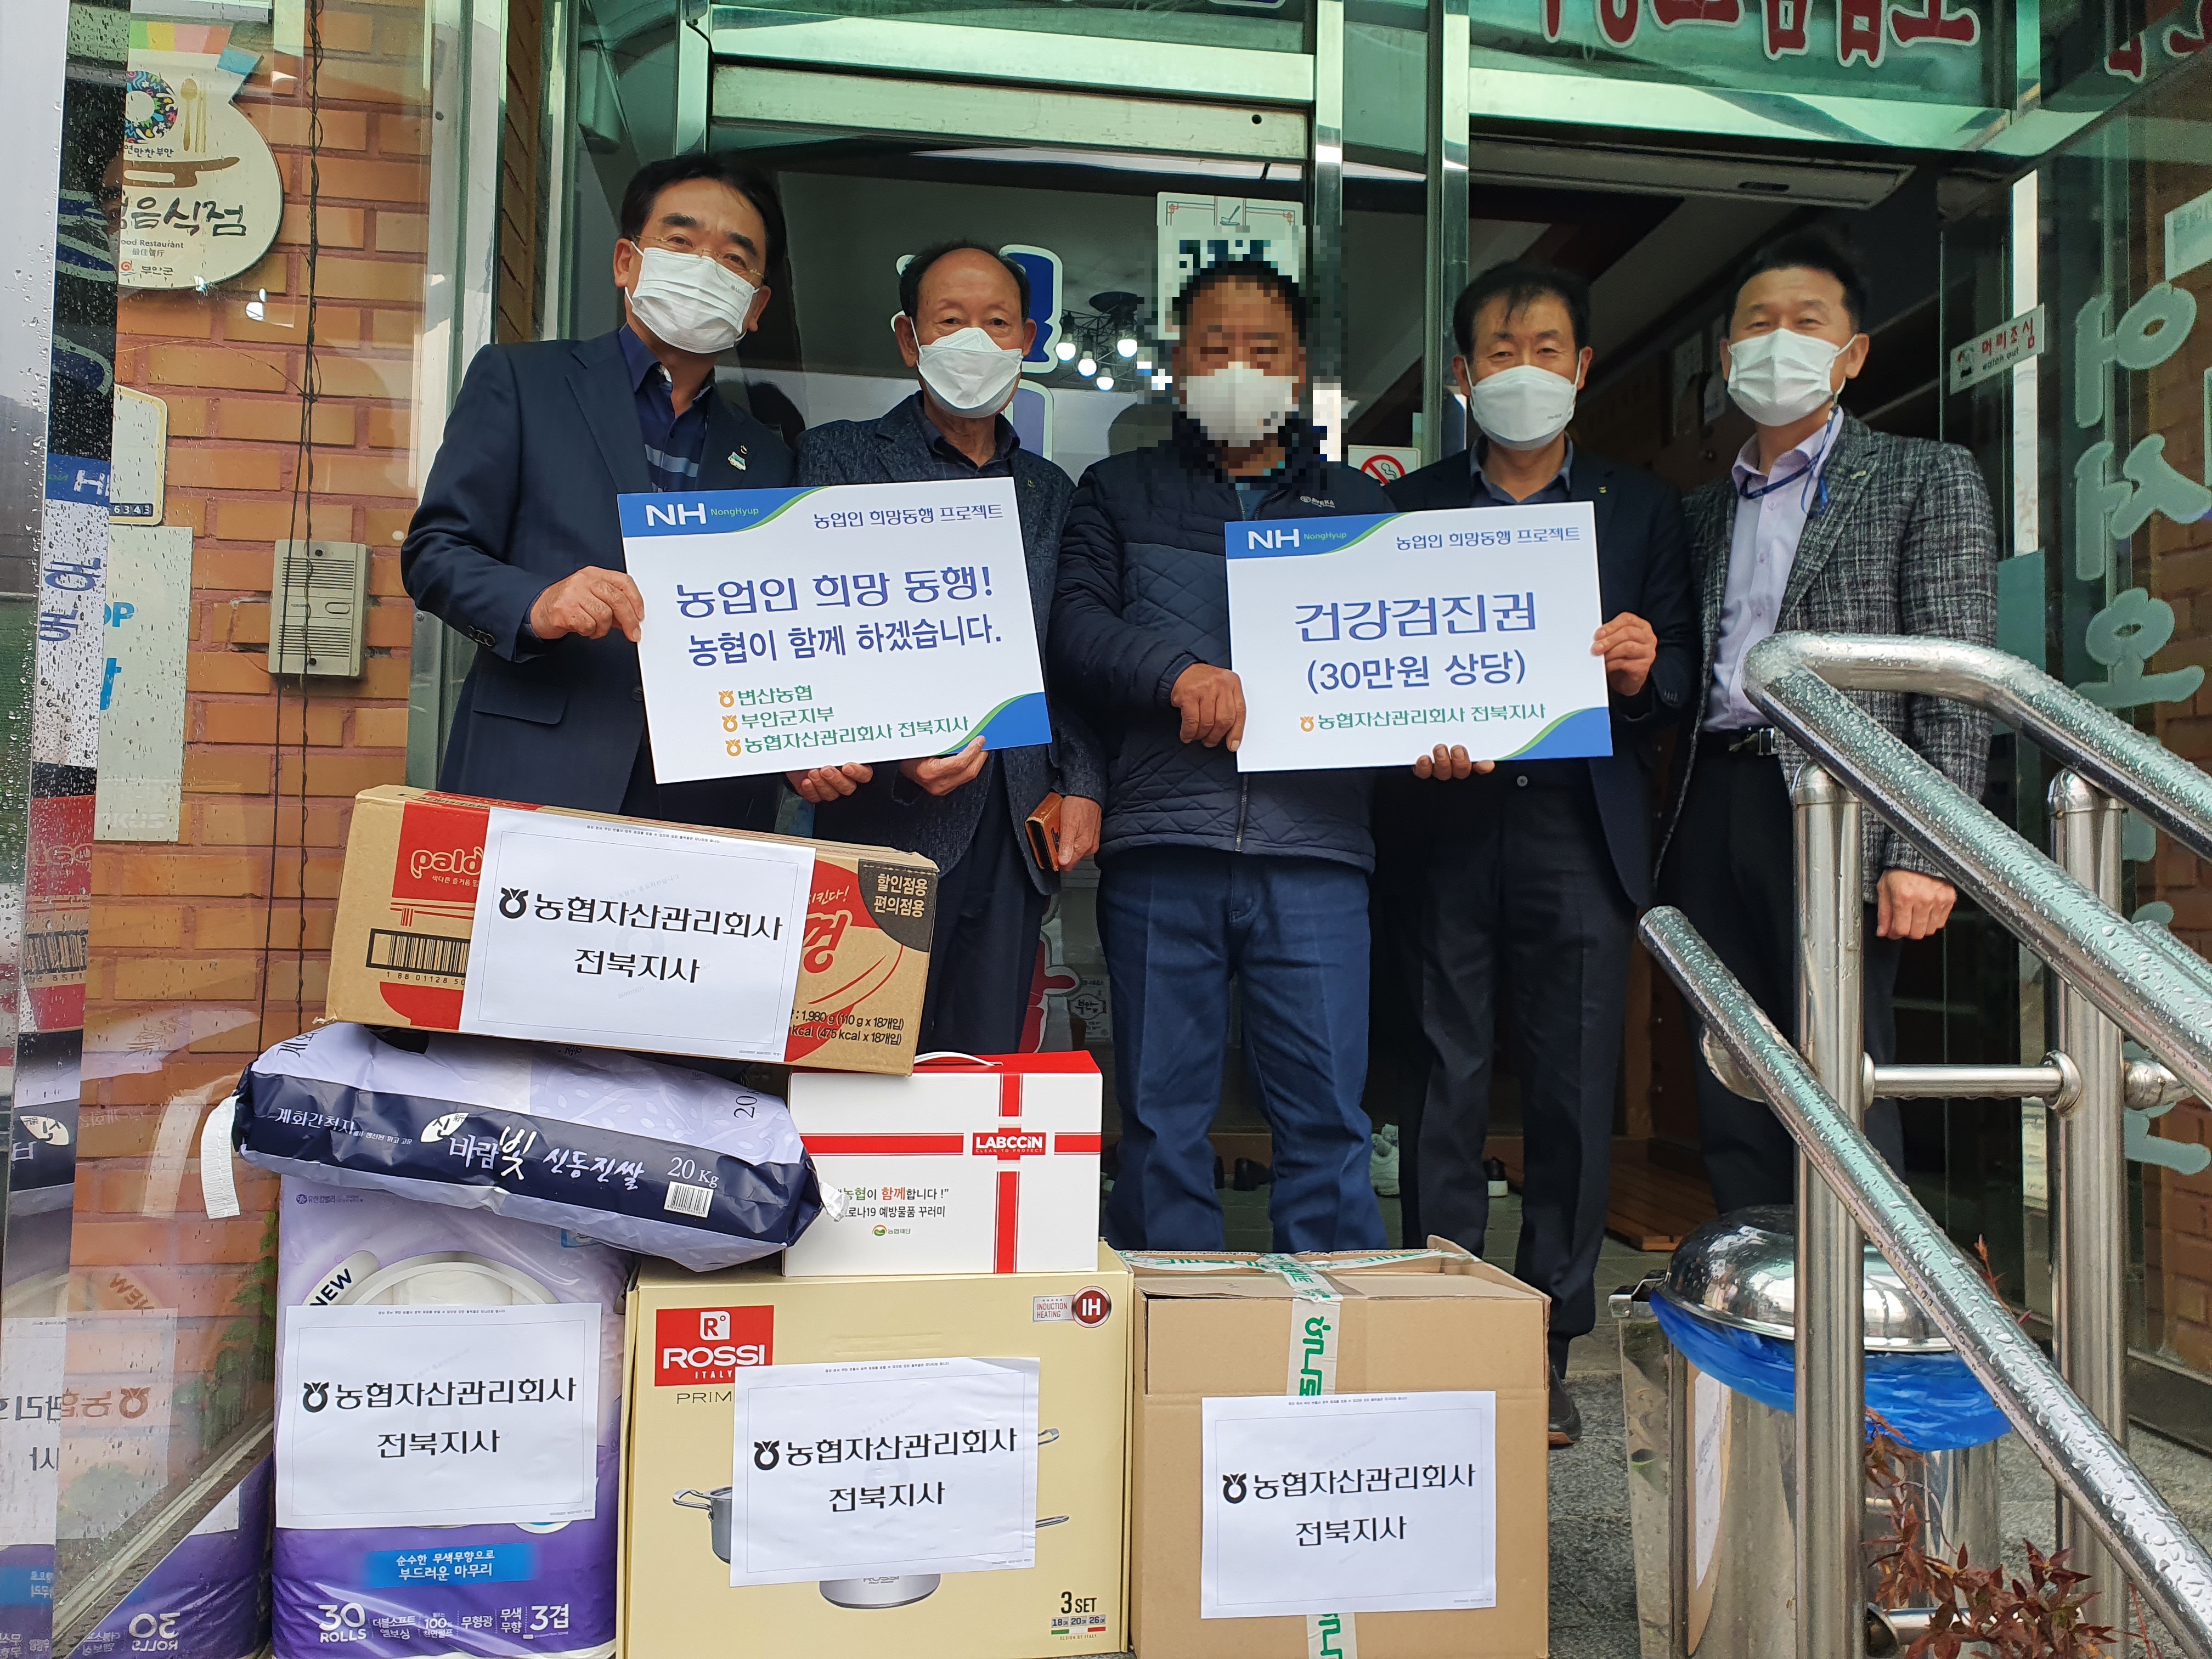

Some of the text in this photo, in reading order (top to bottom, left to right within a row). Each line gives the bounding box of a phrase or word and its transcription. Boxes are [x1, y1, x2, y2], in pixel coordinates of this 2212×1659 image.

[140, 239, 184, 248] Restaurant
[141, 266, 173, 275] 부안군
[1982, 317, 2035, 355] 머리조심
[113, 504, 153, 516] 6343
[646, 502, 759, 526] NH NongHyup
[814, 504, 1004, 529] 농업인 희망동행 프로젝트
[1248, 528, 1347, 550] NH NongHyup
[1396, 527, 1581, 550] 농업인 희망동행 프로젝트
[676, 566, 994, 618] 농업인 희망 동행!
[1295, 592, 1536, 642] 건강검진권
[689, 614, 1002, 667] 농협이 함께 하겠습니다.
[1307, 650, 1526, 693] (30만원 상당)
[738, 685, 813, 707] 변산농협
[742, 707, 834, 729] 부안군지부
[1318, 703, 1546, 730] 농협자산관리회사 전북지사
[744, 716, 968, 753] 농협자산관리회사 전북지사
[432, 875, 450, 884] 색다른
[453, 877, 470, 887] 즐거움
[877, 873, 928, 896] 할인점용
[534, 893, 783, 941] 농협자산관리회사
[873, 895, 925, 918] 편의점용
[574, 949, 700, 984] 전북지사
[416, 974, 448, 984] 01128
[802, 1010, 826, 1022] 1,980
[828, 1015, 834, 1024] g
[837, 1013, 855, 1025] (110
[856, 1018, 862, 1027] g
[873, 1018, 904, 1030] 18개입)
[792, 1026, 813, 1037] kcal
[817, 1026, 837, 1039] (475
[839, 1030, 860, 1041] kcal
[871, 1032, 902, 1046] 18개입)
[275, 1108, 354, 1135] 계화간척지
[544, 1148, 719, 1190] 신동진쌀 20 Kg
[845, 1206, 945, 1218] 로나19 예방물품 꾸러미
[310, 1268, 353, 1306] NEW
[1037, 1302, 1068, 1311] INDUCTION
[1037, 1310, 1061, 1318] HEATING
[1082, 1298, 1101, 1316] IH
[663, 1345, 765, 1369] ROSSI
[695, 1370, 733, 1379] ITALY
[335, 1378, 577, 1409] 농협자산관리회사
[377, 1430, 500, 1458] 전북지사
[786, 1427, 1018, 1466] 농협자산관리회사
[1254, 1463, 1476, 1499] 농협자산관리회사
[828, 1481, 945, 1513] 전북지사
[1296, 1515, 1407, 1547] 전북지사
[396, 1549, 495, 1567] 순수한 무색무향으로
[399, 1563, 492, 1581] 부드러운 마무리
[1061, 1591, 1097, 1613] 3 SET
[318, 1602, 365, 1632] 30
[373, 1616, 416, 1628] 더블소프트
[461, 1616, 493, 1629] 무형광
[500, 1607, 522, 1621] 무색
[529, 1604, 568, 1630] 3겹
[320, 1629, 366, 1643] ROLLS
[380, 1629, 410, 1640] 엠보싱
[500, 1621, 522, 1633] 무향
